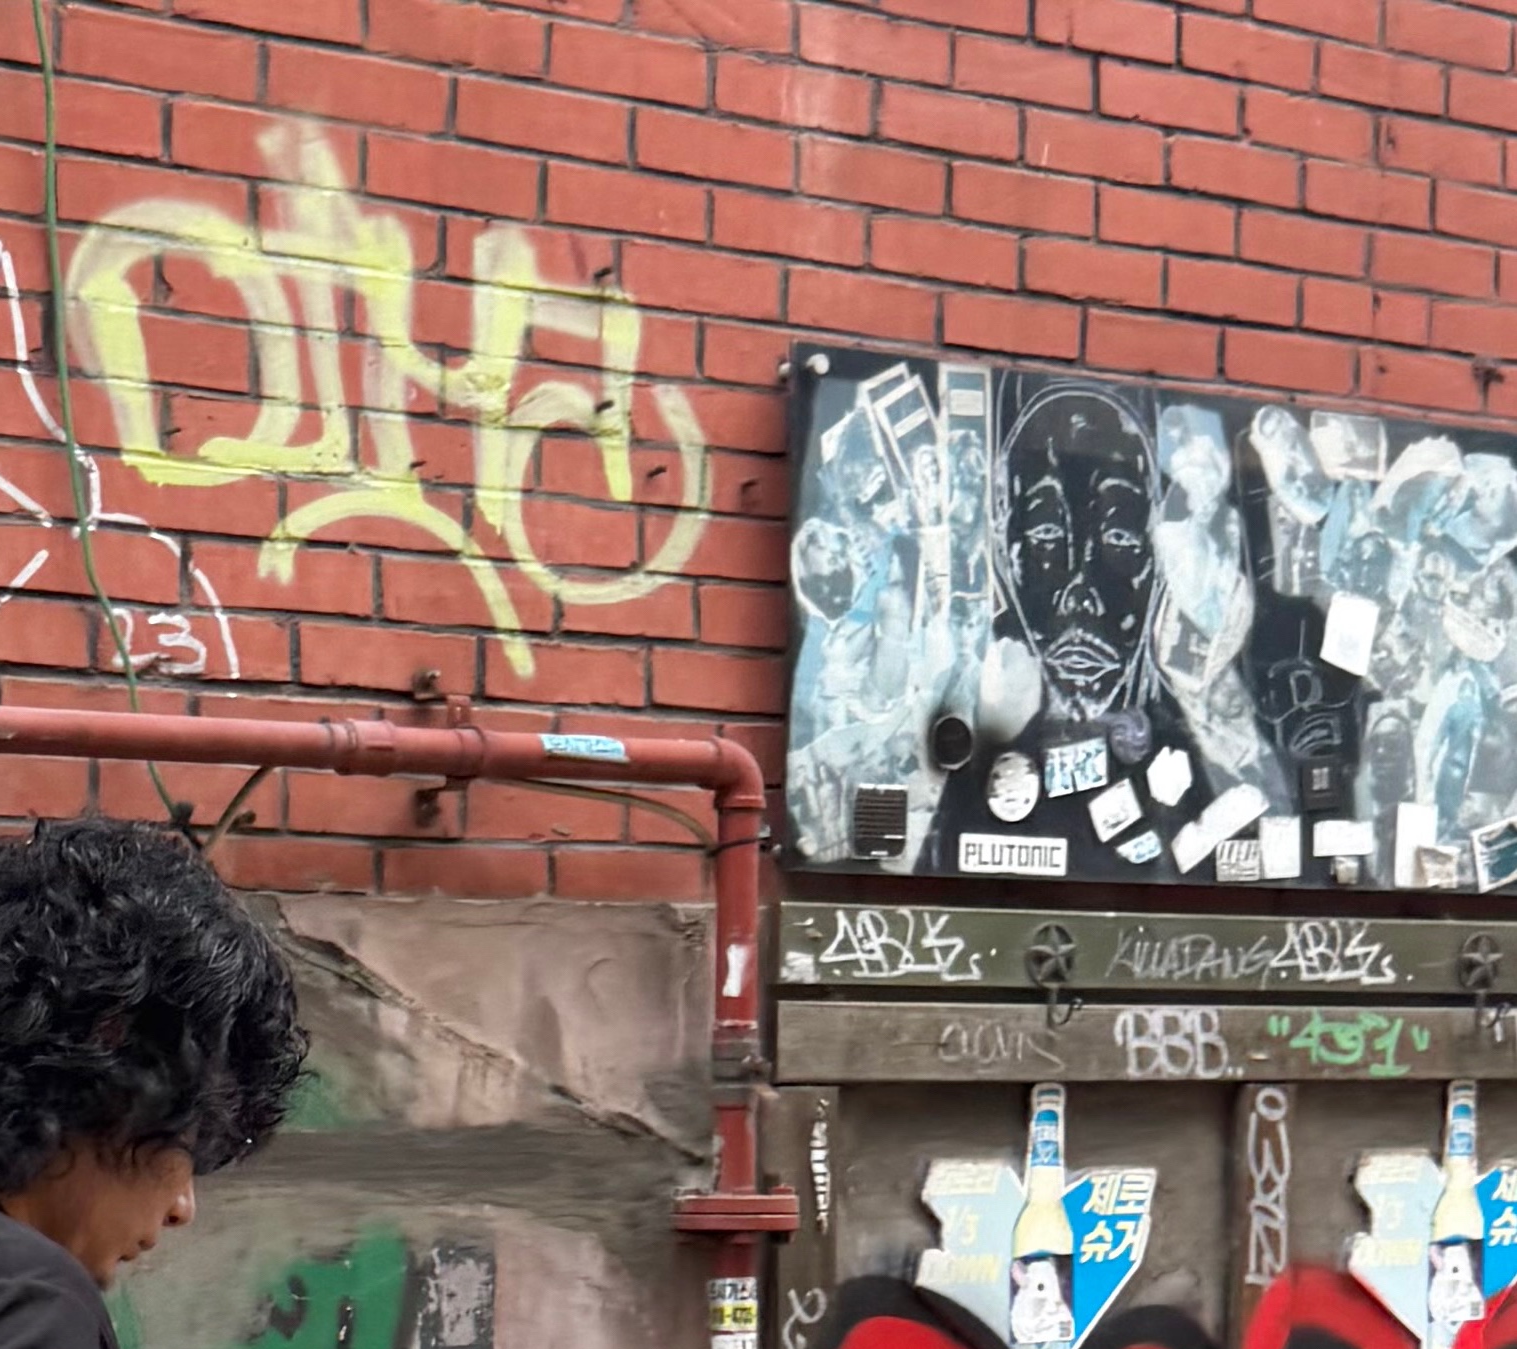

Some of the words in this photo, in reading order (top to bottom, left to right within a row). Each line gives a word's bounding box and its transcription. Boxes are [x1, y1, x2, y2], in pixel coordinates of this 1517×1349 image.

[964, 842, 1062, 869] PLUTONIC
[1083, 1174, 1150, 1216] 제로
[1079, 1219, 1144, 1264] 슈거
